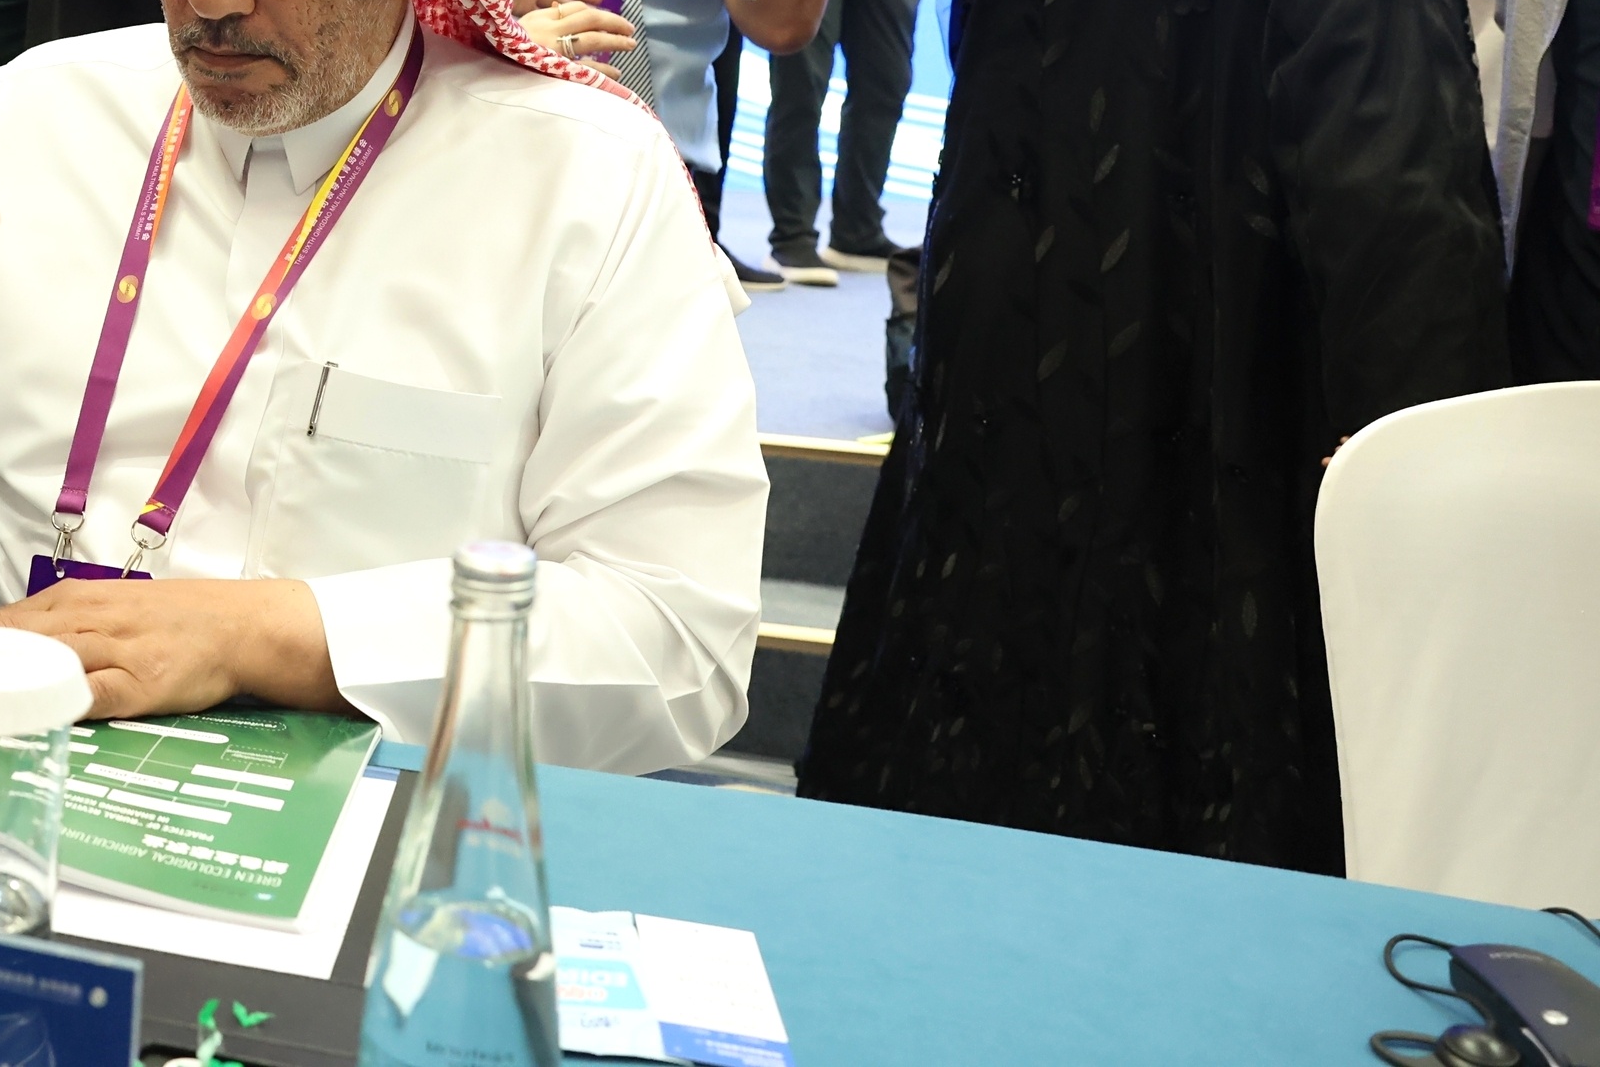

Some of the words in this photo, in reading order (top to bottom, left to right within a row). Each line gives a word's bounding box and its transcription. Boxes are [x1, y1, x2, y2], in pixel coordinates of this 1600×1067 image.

[140, 166, 159, 215] MULTINATIONALS
[295, 253, 306, 266] THE
[302, 236, 316, 254] SIXTH
[313, 210, 333, 238] QINGDAO
[329, 165, 362, 213] MULTINATIONALS
[358, 145, 375, 167] SUMMIT
[134, 218, 144, 240] SUMMIT
[161, 823, 214, 842] PRACTICE
[149, 850, 231, 878] ECOLOGICAL
[234, 869, 282, 888] GREEN
